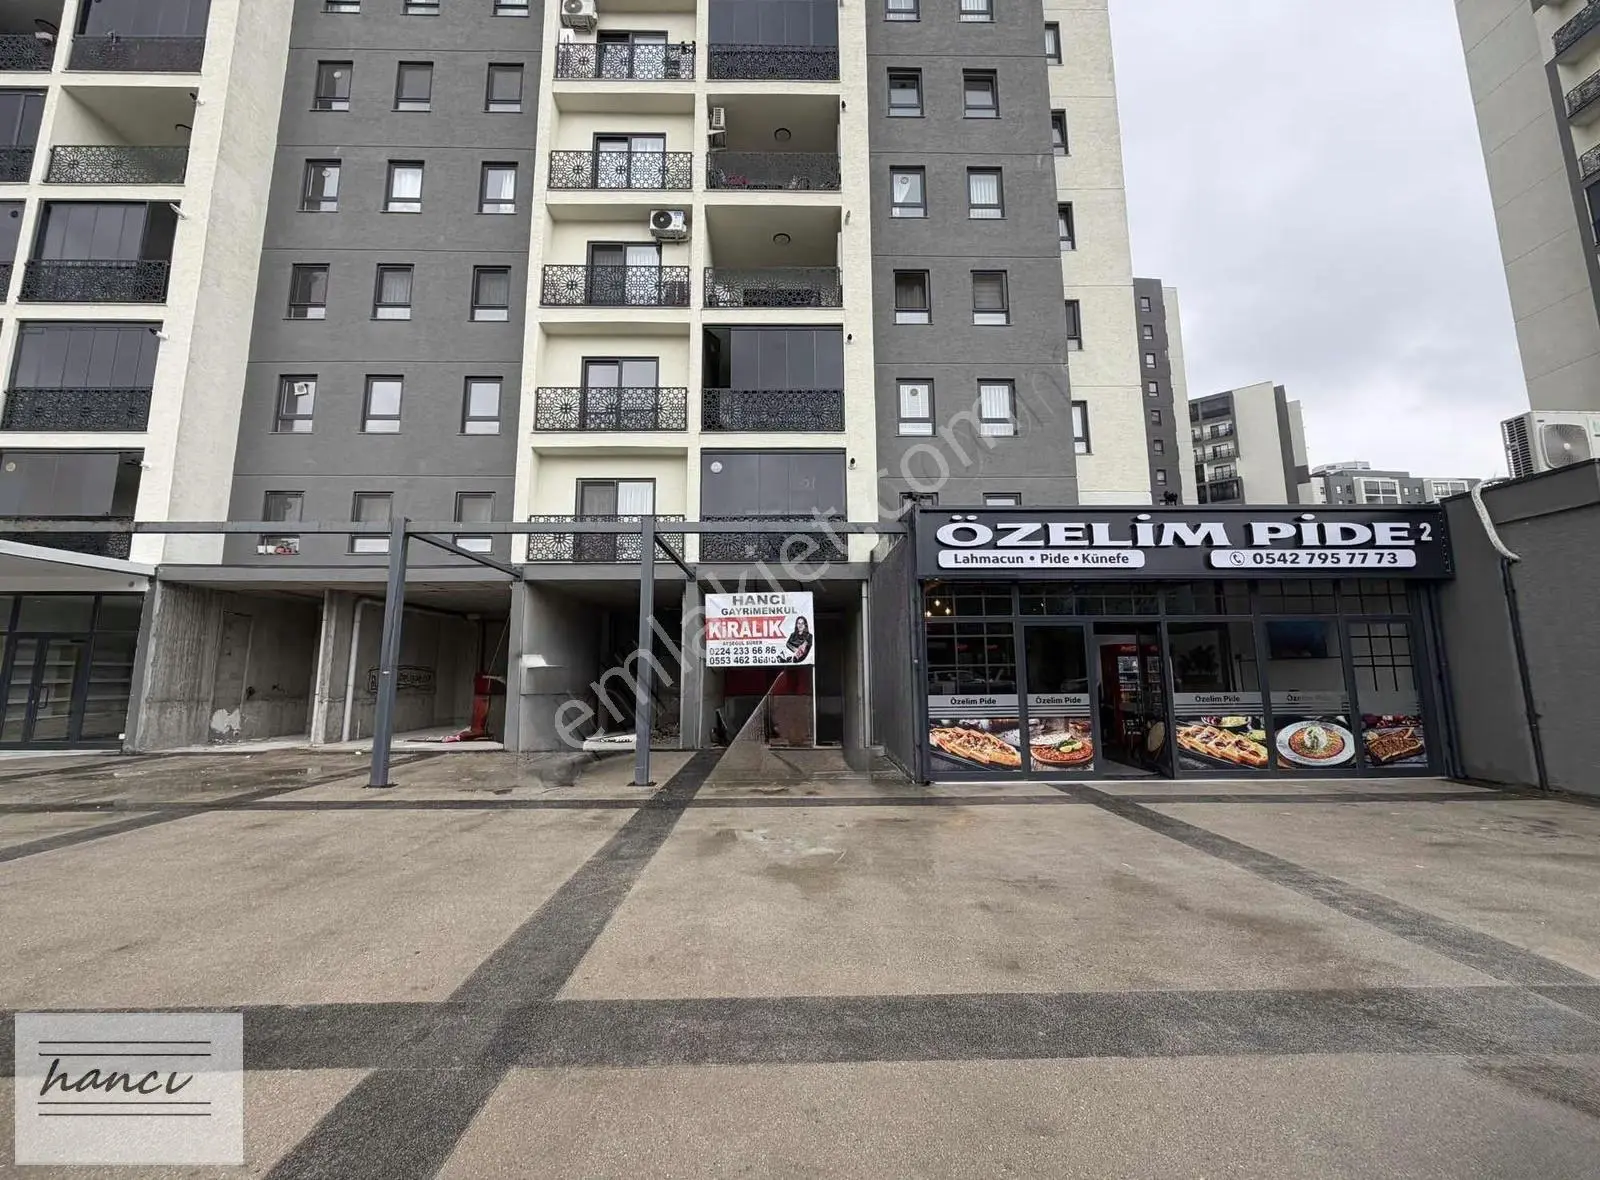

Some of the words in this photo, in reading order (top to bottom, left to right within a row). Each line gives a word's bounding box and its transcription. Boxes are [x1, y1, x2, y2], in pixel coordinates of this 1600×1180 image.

[1419, 522, 1433, 542] 2
[953, 552, 1025, 564] Lahmacun
[1040, 552, 1071, 564] Pide
[1081, 552, 1130, 564] Künefe
[1252, 552, 1300, 565] 0542
[1305, 552, 1341, 565] 795
[1345, 552, 1369, 565] 77
[1374, 552, 1399, 565] 73
[709, 647, 731, 656] 0224
[733, 647, 750, 656] 233
[709, 656, 731, 665] 0553
[733, 655, 750, 665] 462
[979, 697, 997, 705] Pide
[1064, 695, 1082, 704] Pide
